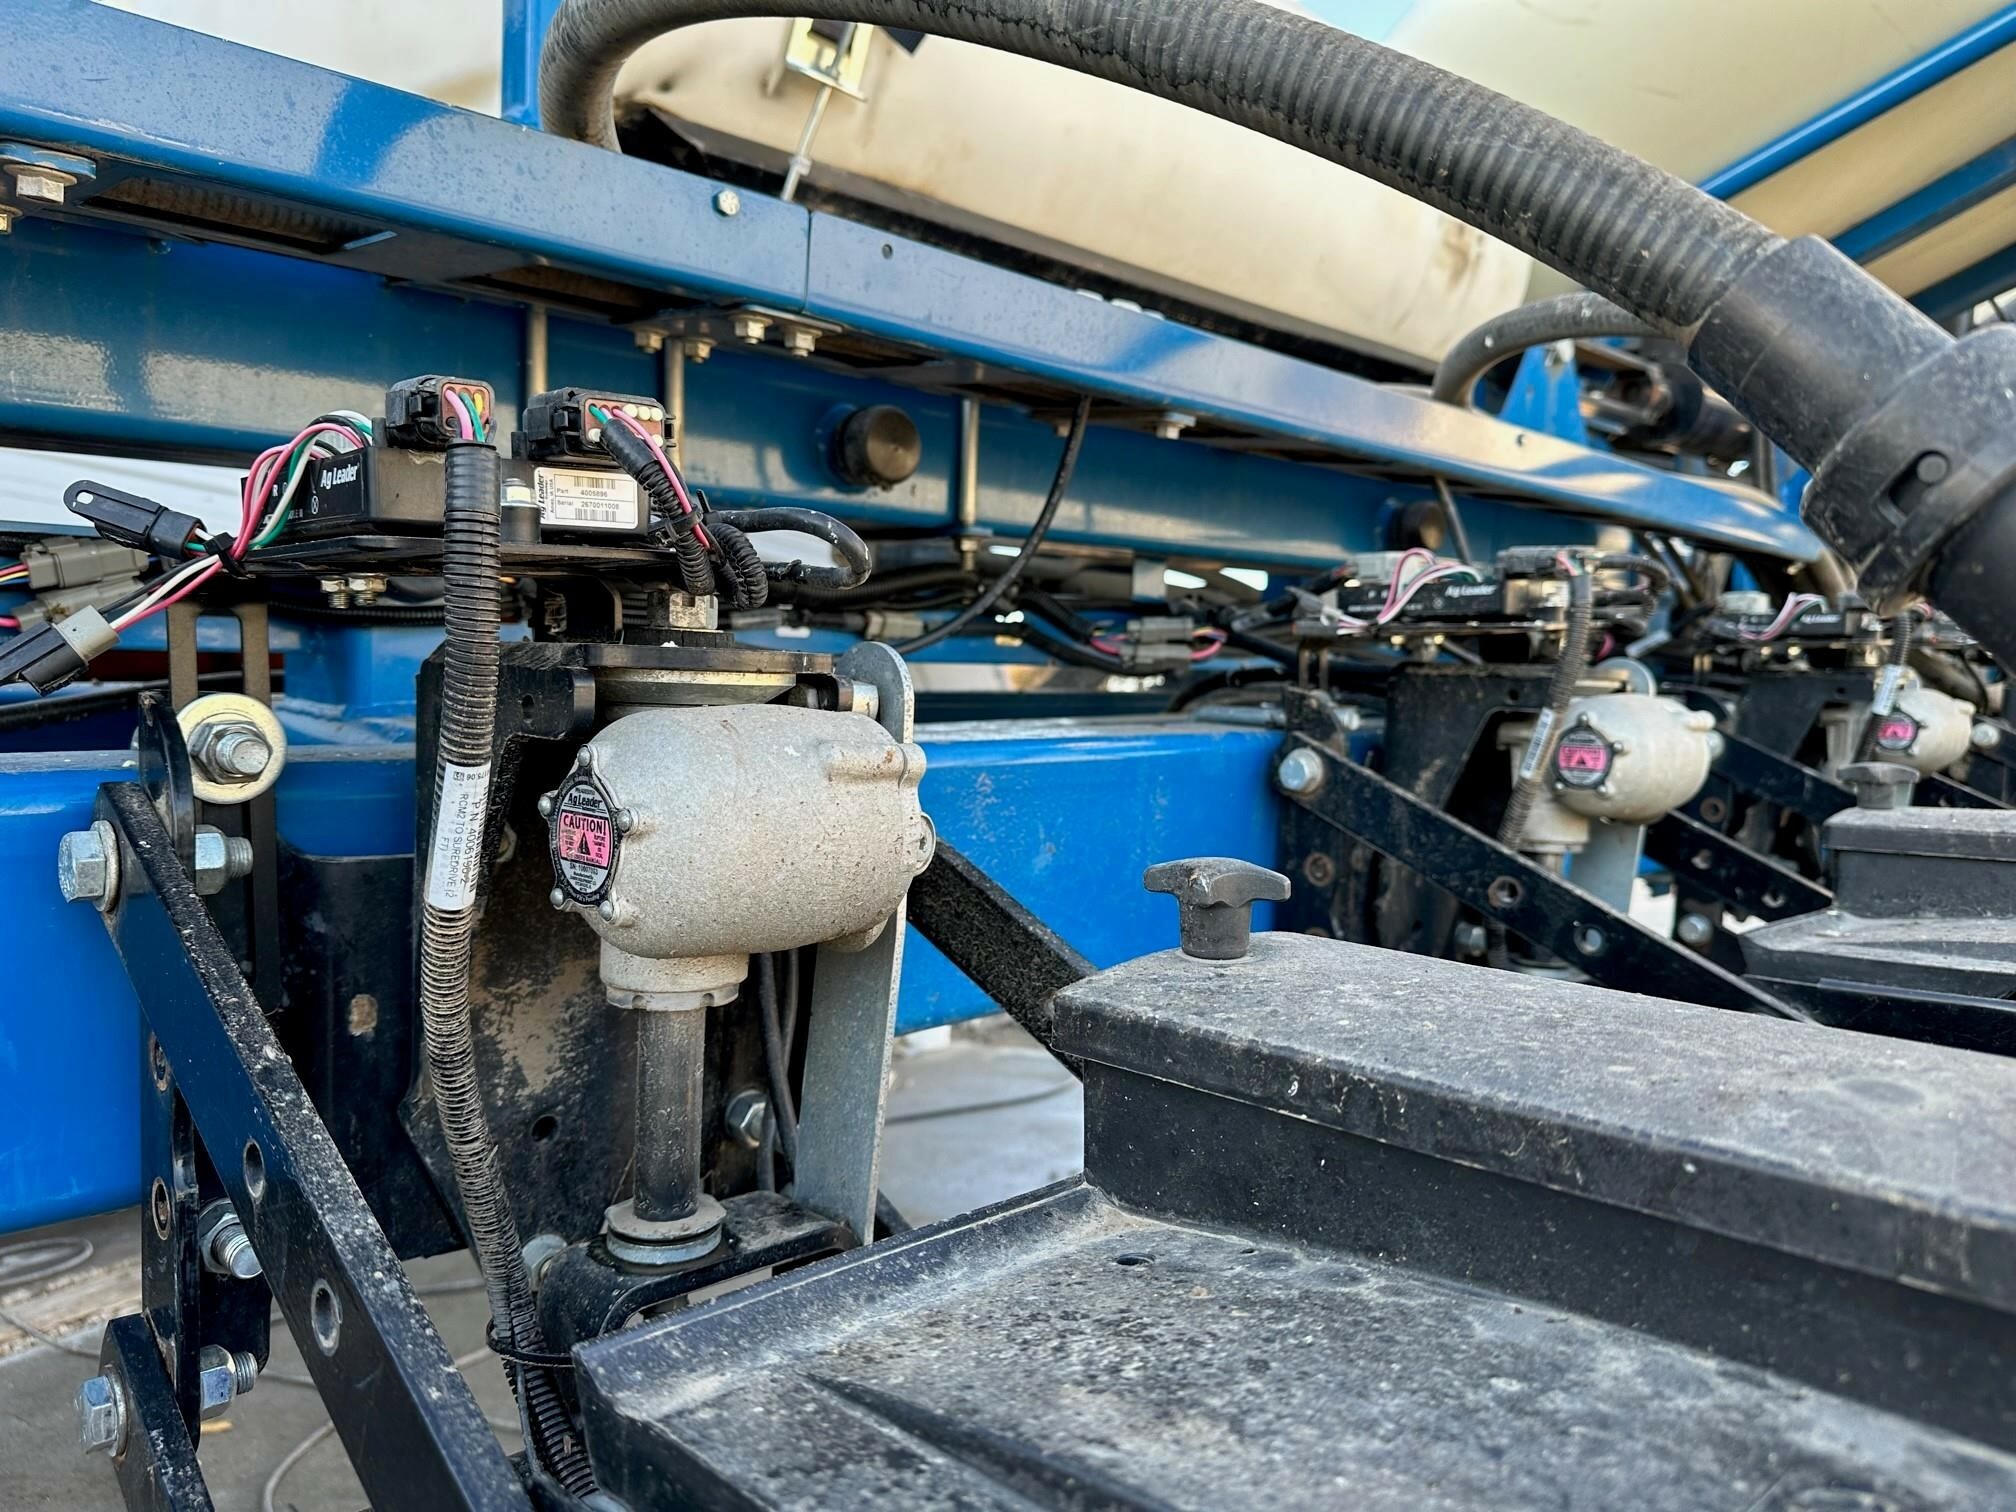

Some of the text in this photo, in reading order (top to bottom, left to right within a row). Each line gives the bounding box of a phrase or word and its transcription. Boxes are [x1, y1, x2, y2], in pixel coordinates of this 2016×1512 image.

[320, 464, 359, 489] Ag Leader
[568, 792, 578, 806] Ag
[578, 794, 603, 809] Leader
[563, 814, 606, 836] CAUTION!
[446, 837, 462, 887] SUREDRIVE
